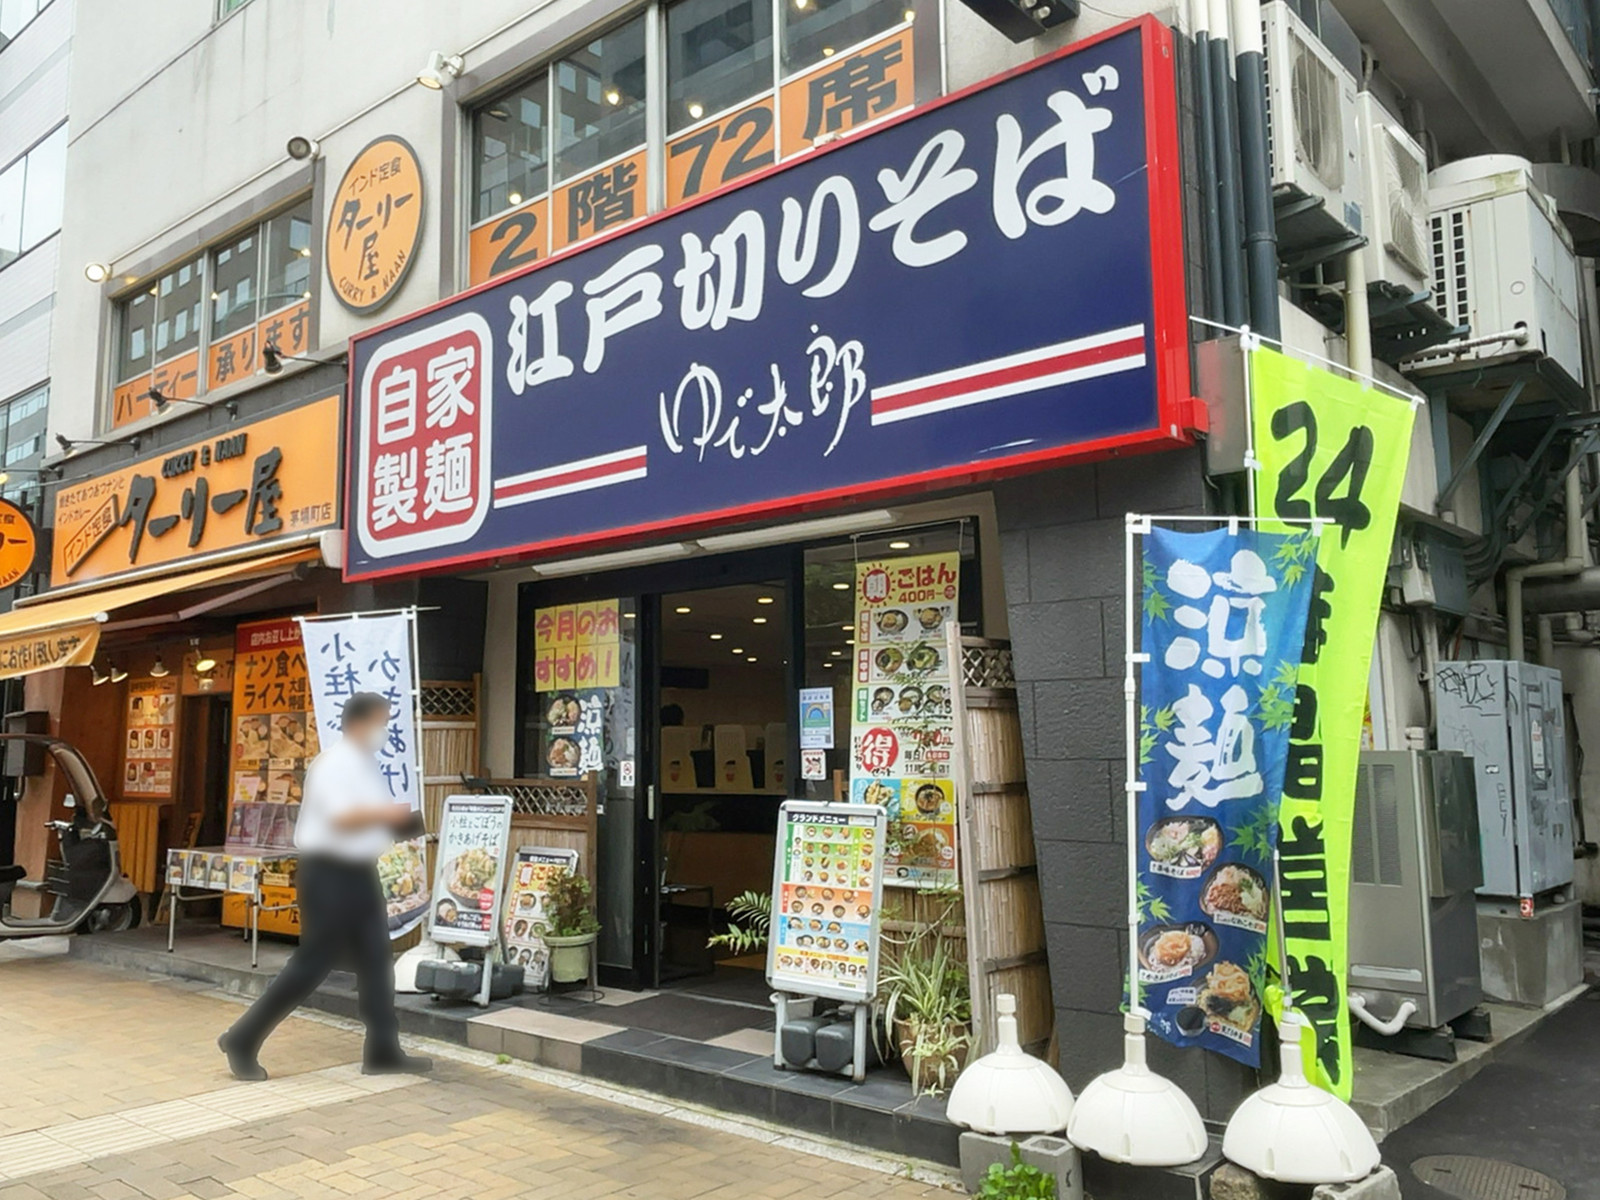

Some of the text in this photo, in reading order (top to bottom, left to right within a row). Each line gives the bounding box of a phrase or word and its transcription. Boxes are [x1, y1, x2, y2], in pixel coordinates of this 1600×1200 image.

[488, 38, 903, 277] 2階 72席
[336, 192, 414, 251] ターリー
[506, 64, 1116, 395] 江戸切りそば
[339, 276, 364, 303] CURRY
[382, 249, 406, 291] NAAN
[357, 230, 380, 282] 屋
[376, 345, 475, 445] 自家
[659, 325, 867, 462] ゆで太郎
[372, 432, 474, 532] 製麺
[1271, 400, 1374, 550] 24
[119, 446, 283, 564] ターリー屋
[0, 567, 21, 586] AAN
[897, 562, 957, 589] ごはん
[535, 606, 618, 643] 今月のお
[244, 682, 287, 710] ライス
[1164, 549, 1278, 812] 涼麺
[862, 734, 893, 768] 得
[792, 813, 846, 824] グランドメニュー
